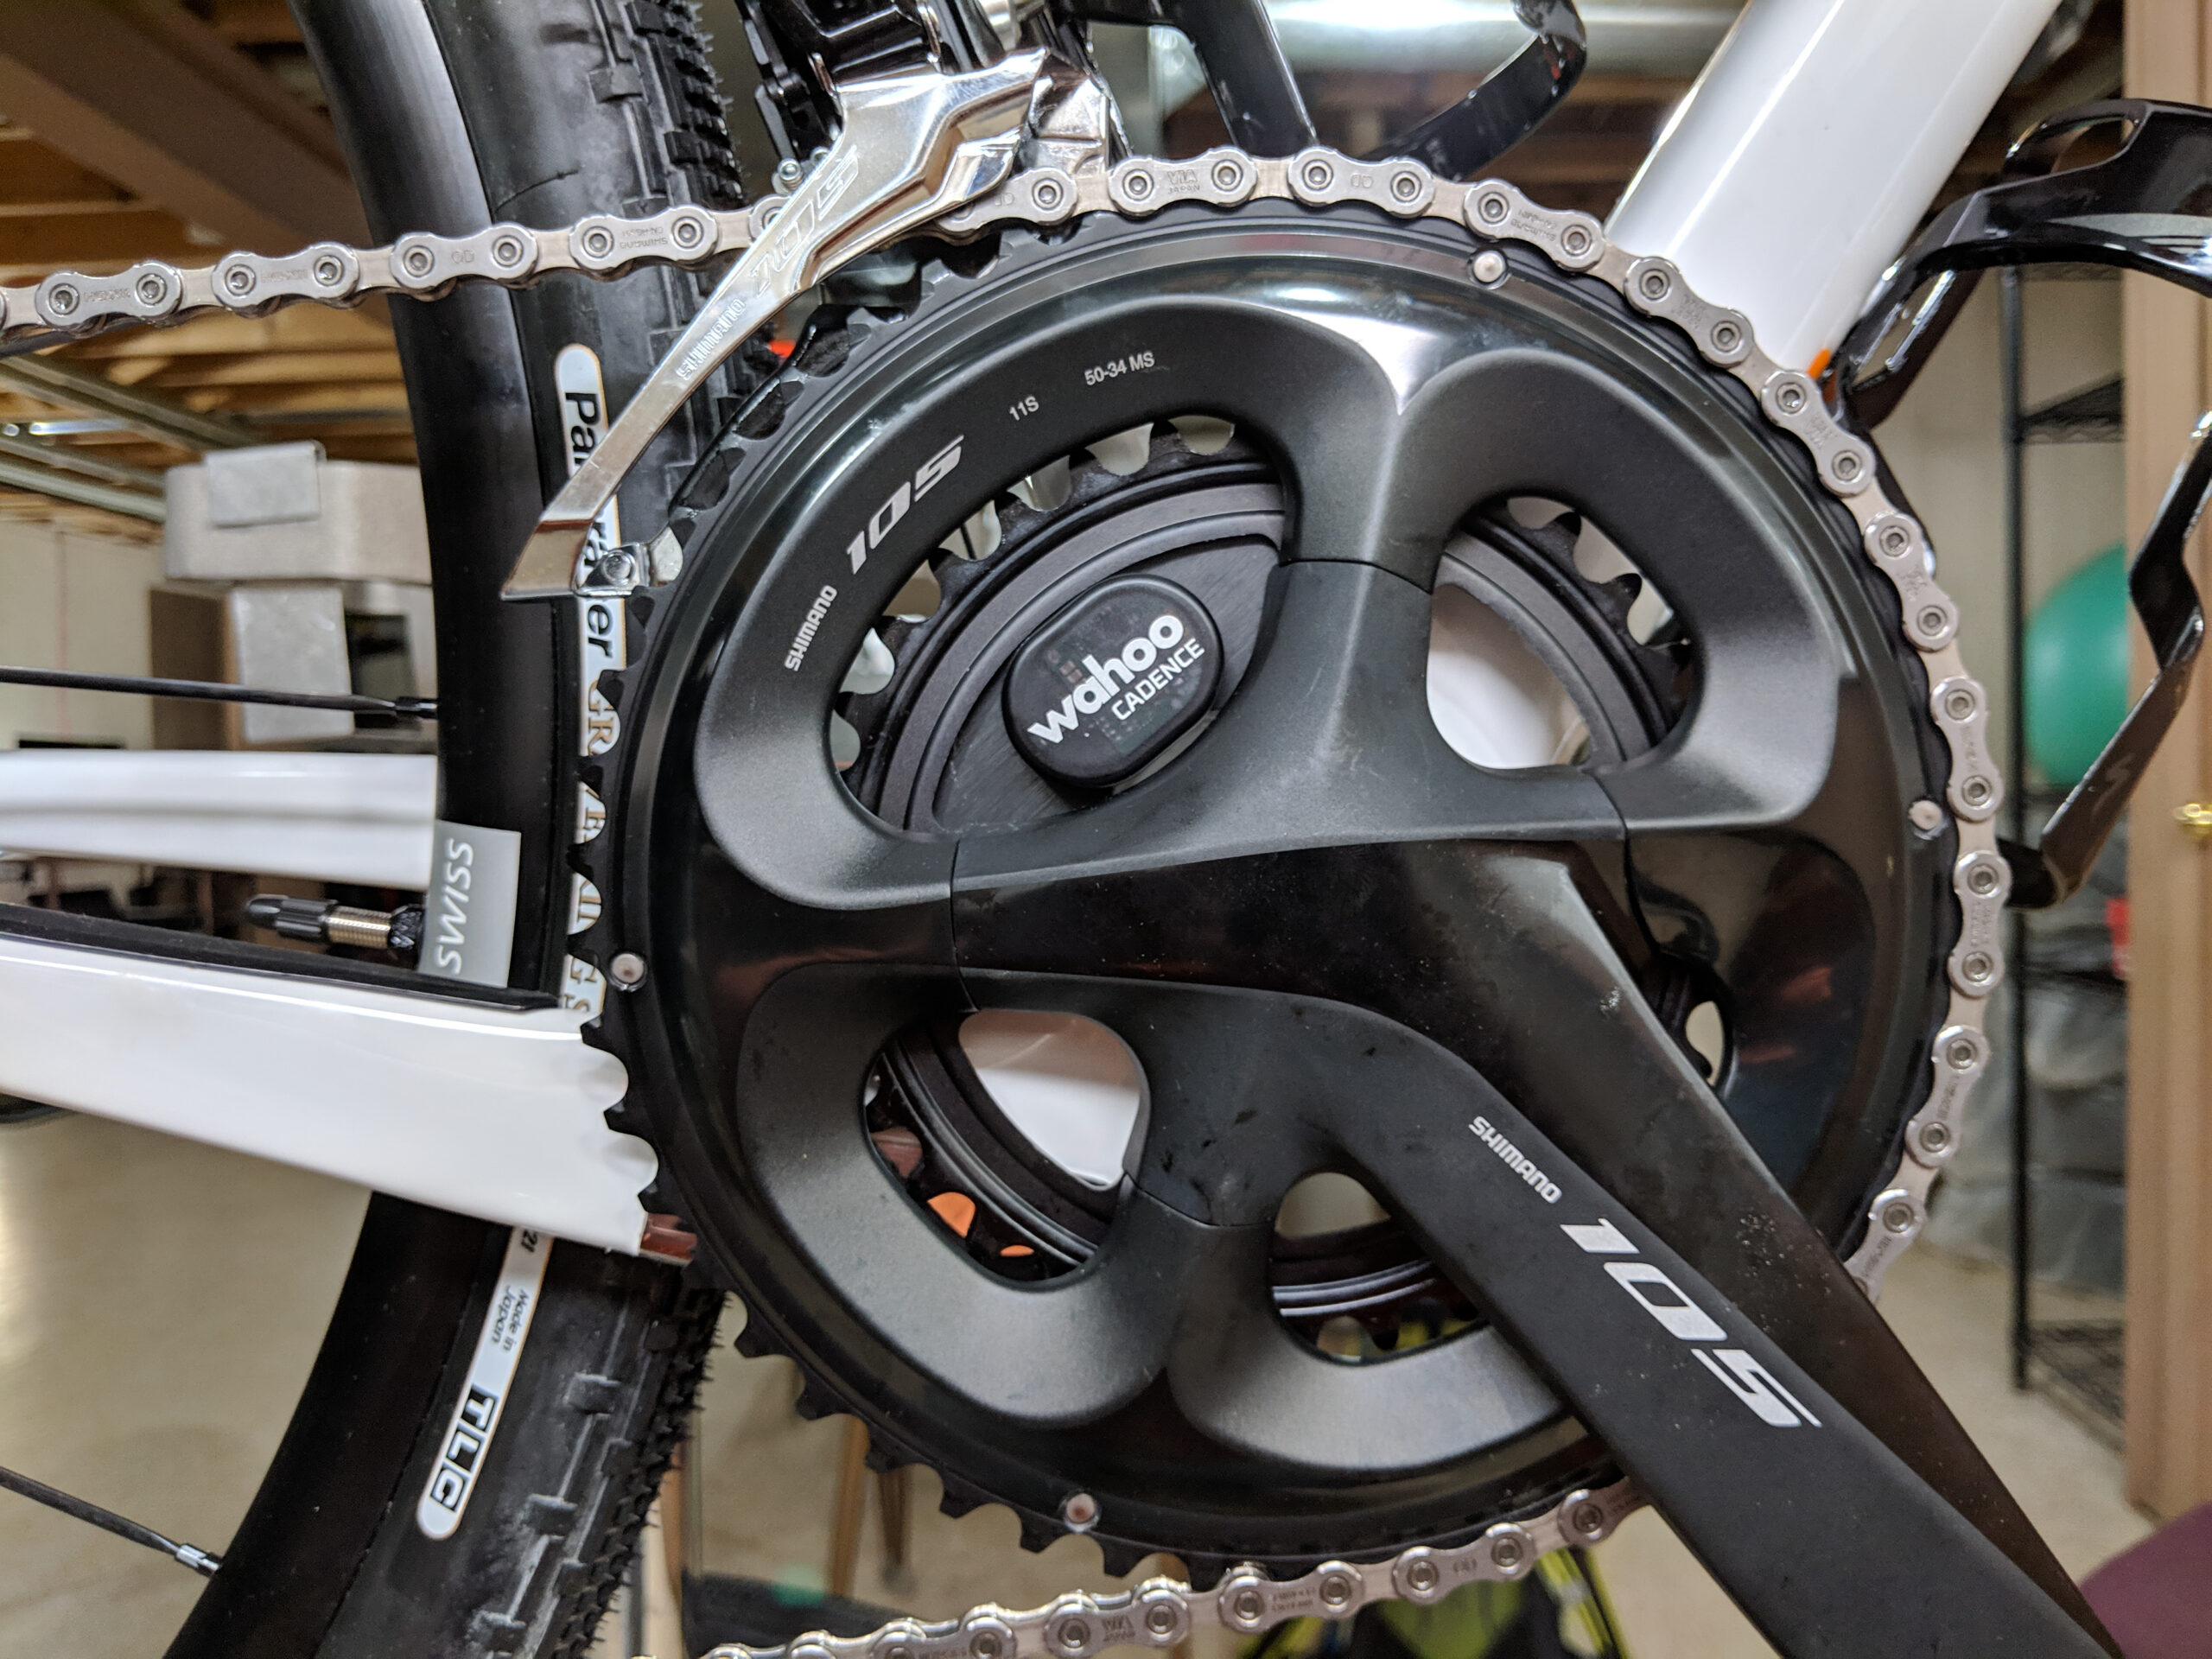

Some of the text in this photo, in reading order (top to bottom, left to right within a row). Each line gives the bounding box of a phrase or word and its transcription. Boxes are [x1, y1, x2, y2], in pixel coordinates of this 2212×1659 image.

[750, 144, 859, 298] 105
[1168, 184, 1200, 194] JAPAN
[676, 298, 747, 381] SHIMANO
[1084, 351, 1156, 385] 50-34 MS
[1009, 396, 1039, 421] 11S
[846, 435, 965, 575] 105
[784, 584, 838, 672] SHIMANO
[1027, 615, 1185, 744] wahoo
[1111, 638, 1206, 721] CADENCE
[436, 837, 474, 976] SWISS
[1468, 1116, 1563, 1205] SHIMANO
[492, 1285, 516, 1344] Japan
[503, 1288, 531, 1353] Made in
[1559, 1217, 1823, 1427] 105
[430, 1386, 498, 1512] TLC
